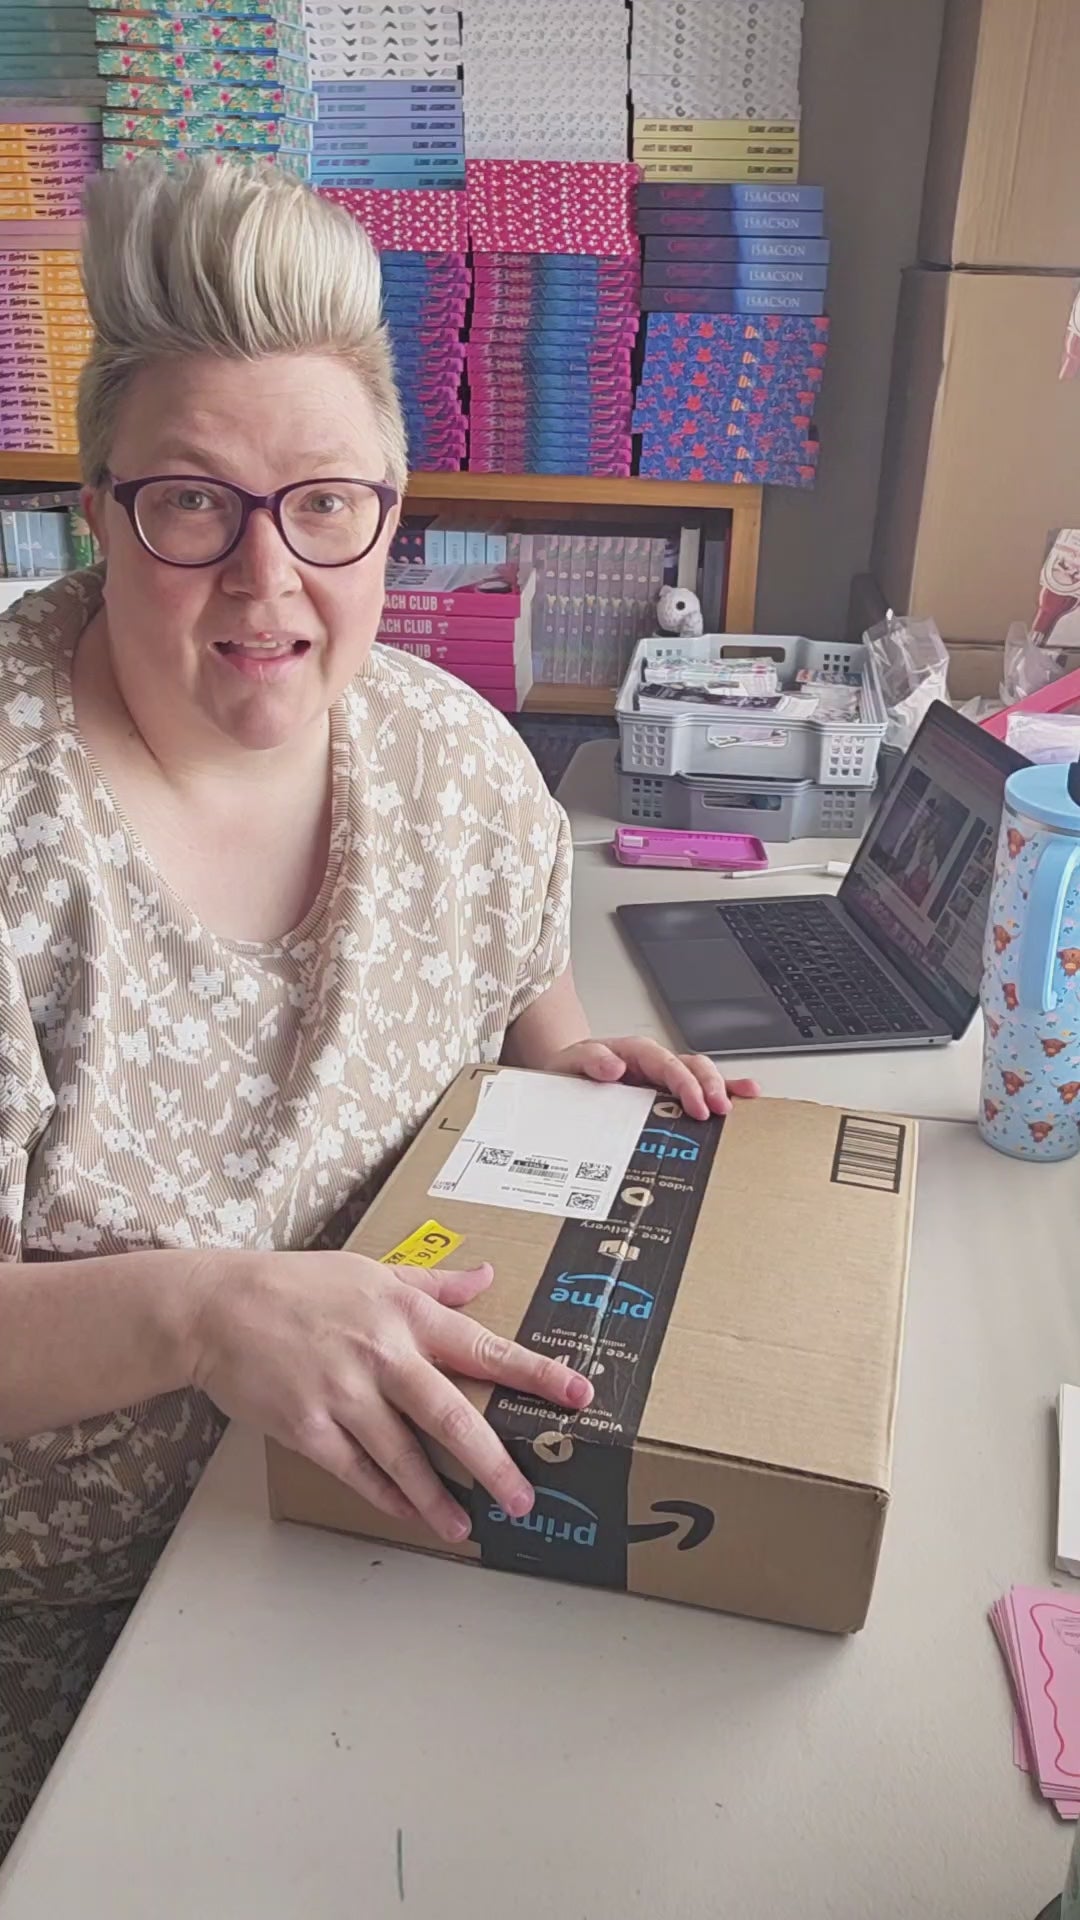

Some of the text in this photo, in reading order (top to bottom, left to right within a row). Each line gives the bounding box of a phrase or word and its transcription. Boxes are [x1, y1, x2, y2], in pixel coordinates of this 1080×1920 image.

[744, 191, 800, 203] ISAACSON
[744, 217, 800, 229] ISAACSON
[751, 244, 806, 256] ISAACSON
[749, 270, 804, 282] ISAACSON
[746, 295, 800, 308] ISAACSON
[383, 594, 437, 611] ACH CLUB
[379, 618, 432, 634] ACH CLUB
[658, 1180, 695, 1193] video
[423, 1232, 451, 1248] G
[641, 1231, 671, 1244] free
[605, 1347, 640, 1363] free
[497, 1399, 624, 1434] video streaming
[488, 1504, 598, 1547] prime
